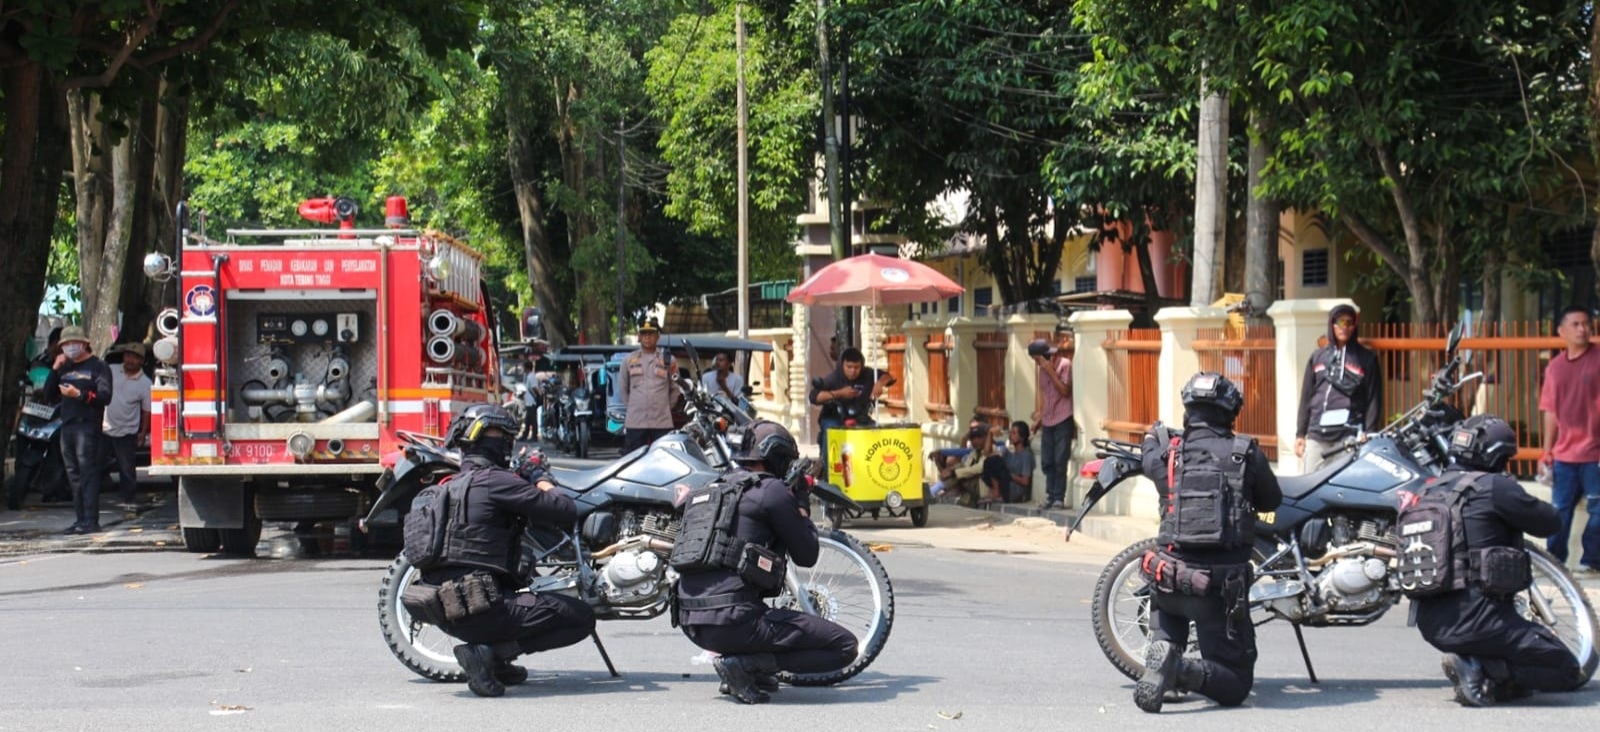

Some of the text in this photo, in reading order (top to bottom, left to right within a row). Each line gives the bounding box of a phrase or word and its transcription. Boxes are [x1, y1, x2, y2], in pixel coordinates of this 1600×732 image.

[865, 441, 882, 462] KOPI
[882, 438, 892, 446] DI
[893, 438, 913, 461] RODA
